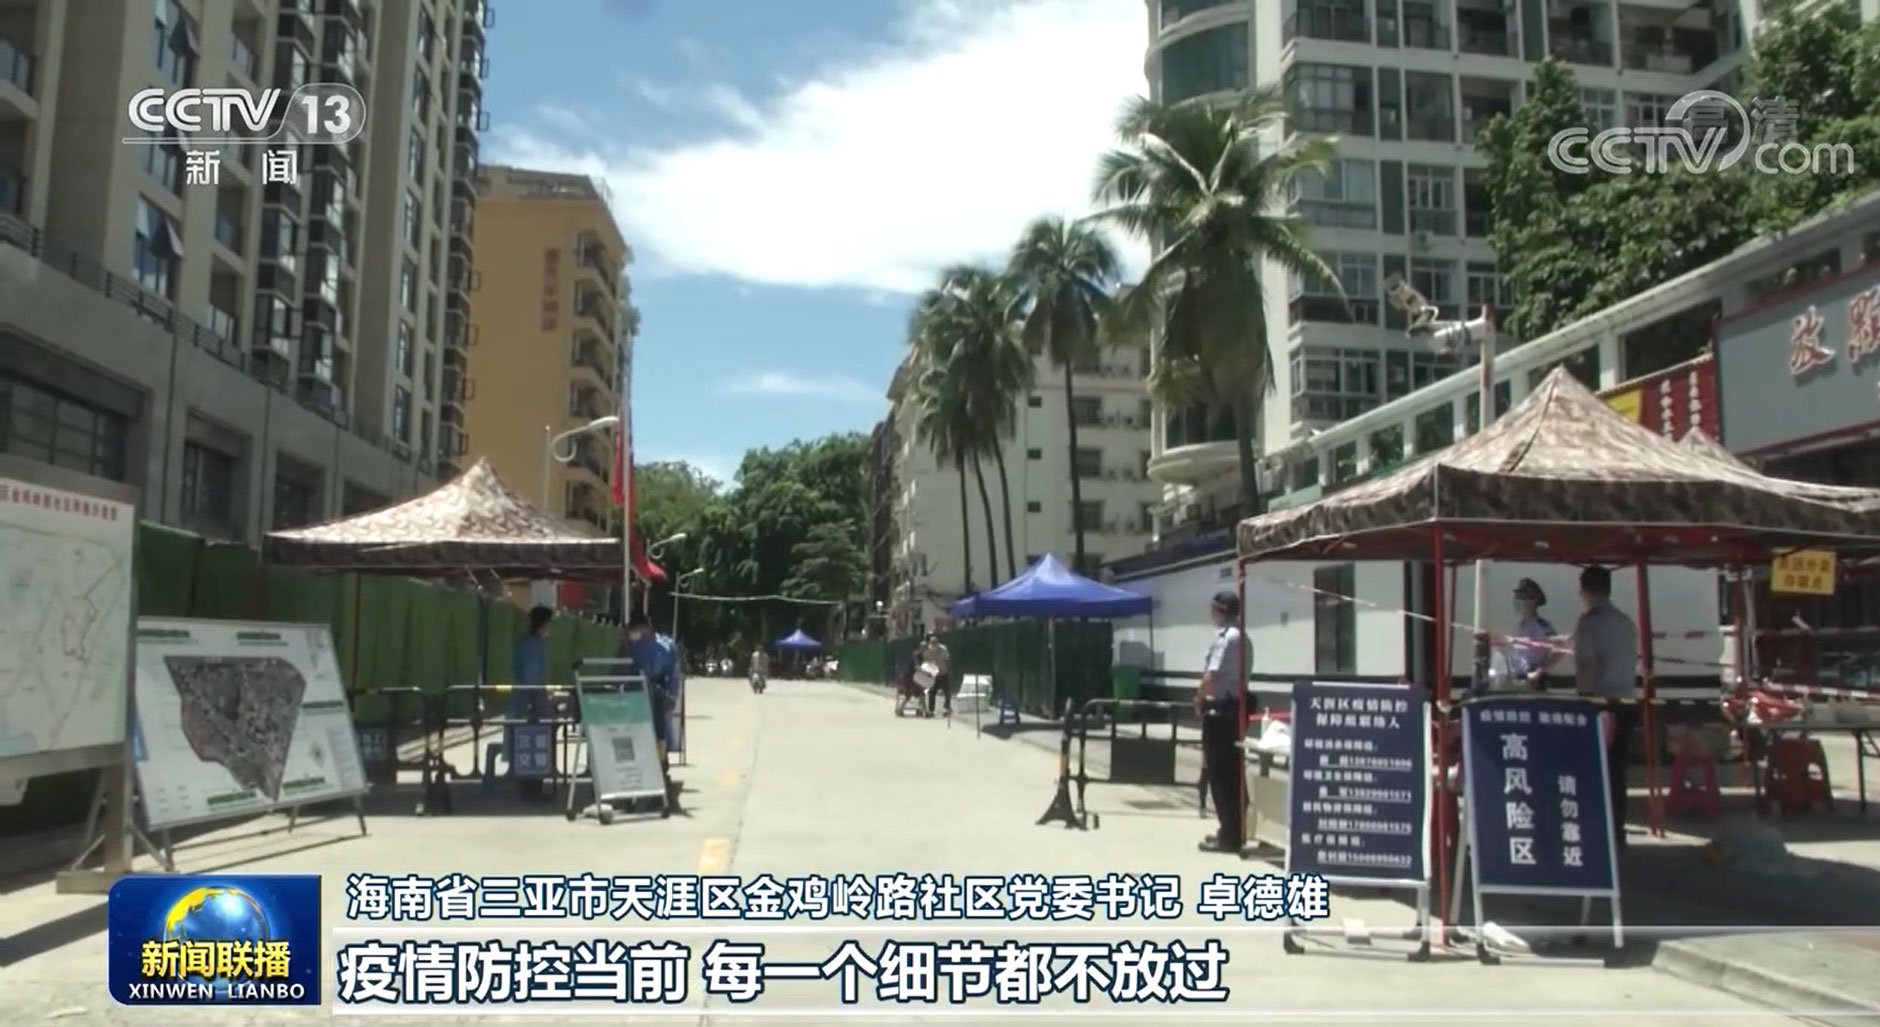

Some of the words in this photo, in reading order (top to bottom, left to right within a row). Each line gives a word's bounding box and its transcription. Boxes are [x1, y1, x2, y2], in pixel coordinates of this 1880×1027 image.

[1500, 733, 1537, 865] 高风险区
[1558, 775, 1583, 867] 请勿靠近
